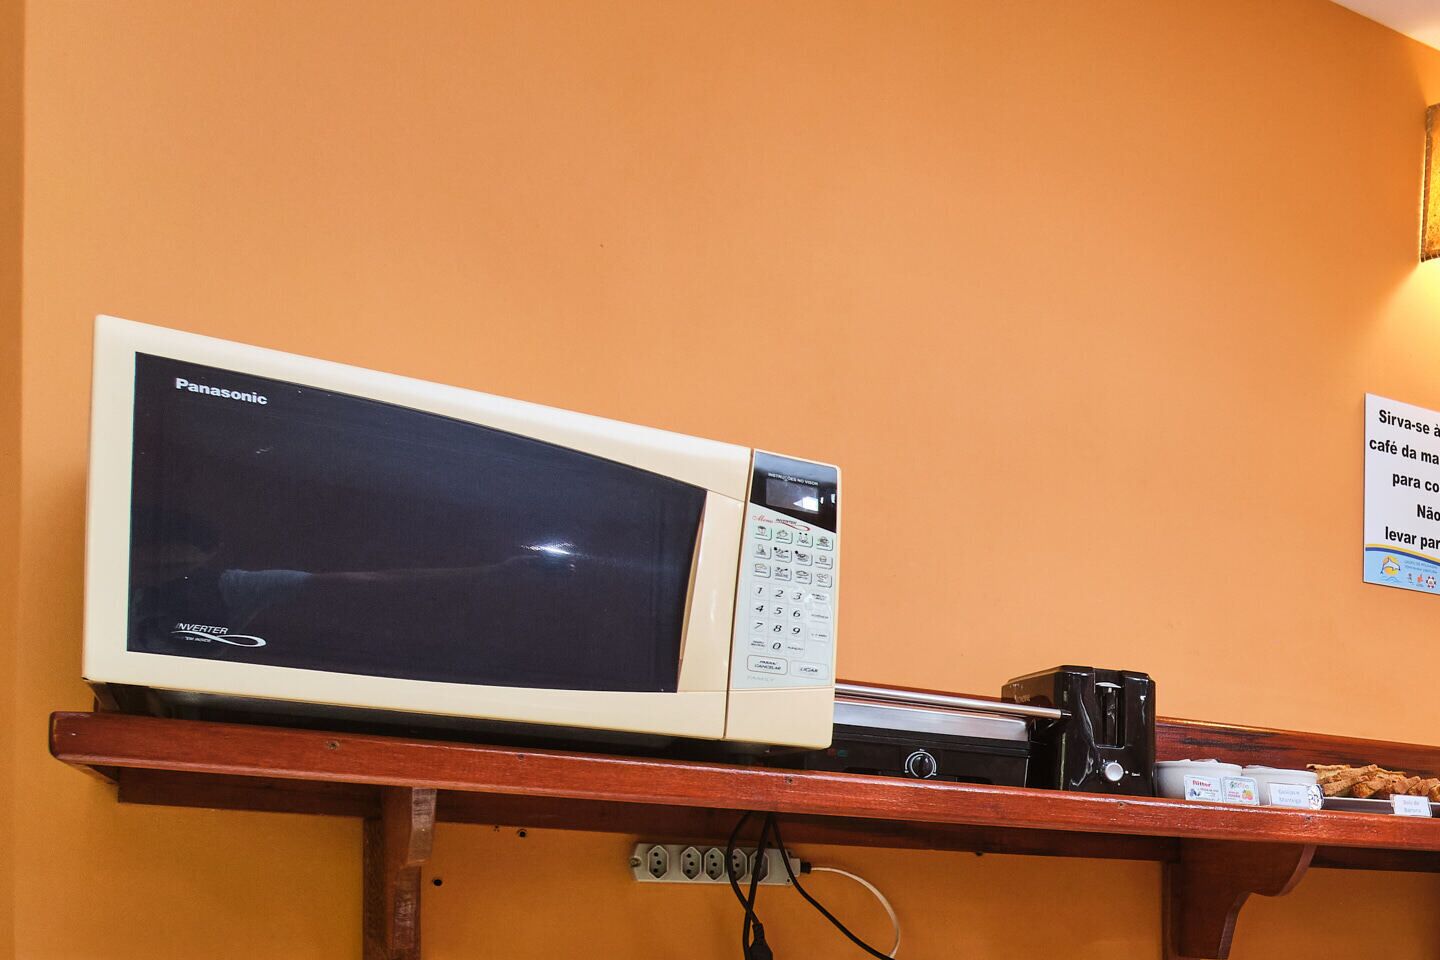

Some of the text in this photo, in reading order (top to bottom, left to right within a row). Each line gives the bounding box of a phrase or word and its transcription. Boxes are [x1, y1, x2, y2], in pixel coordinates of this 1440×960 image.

[175, 377, 268, 405] Panasonic
[1378, 409, 1430, 435] Sirva-se
[1433, 422, 1440, 438] à
[1369, 438, 1398, 455] café
[1401, 444, 1417, 460] da
[1392, 473, 1421, 489] para
[1385, 526, 1417, 545] levar
[775, 589, 784, 598] 2
[793, 592, 802, 601] 3
[755, 605, 801, 618] 4 5 6
[175, 622, 229, 635] INVERTER
[754, 622, 801, 635] 7 8 9
[772, 642, 781, 650] 0
